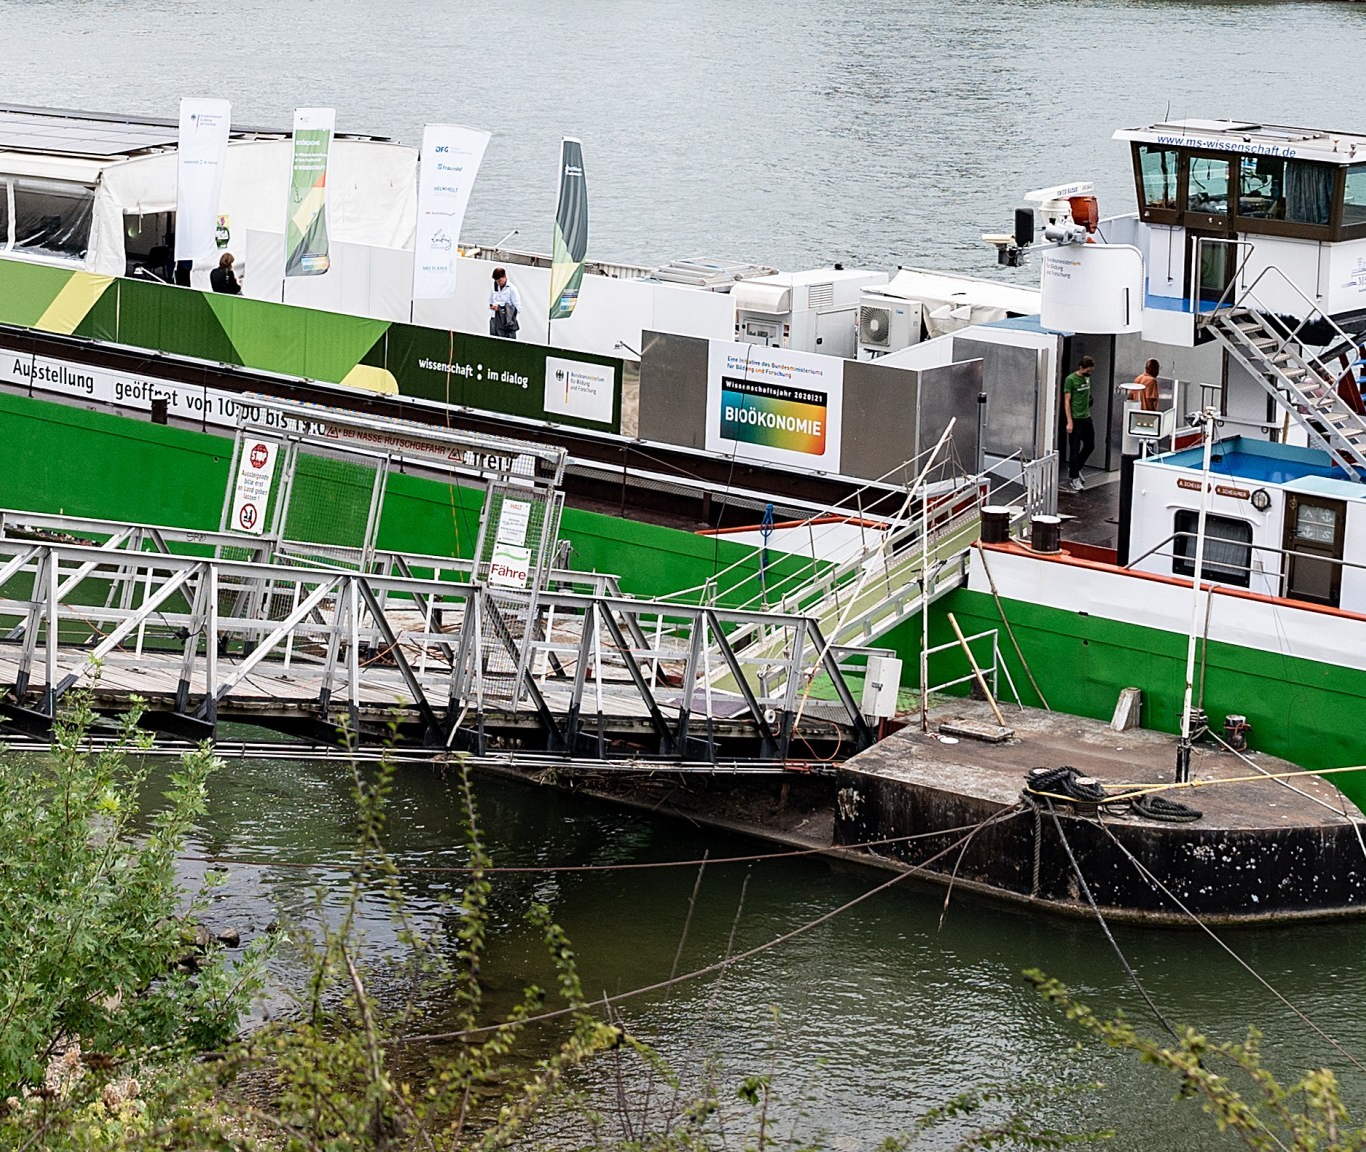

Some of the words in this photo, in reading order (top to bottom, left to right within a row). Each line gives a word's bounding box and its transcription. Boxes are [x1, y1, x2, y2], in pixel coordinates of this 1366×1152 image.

[1157, 136, 1296, 157] www.ms-wissenschaft.de
[418, 358, 473, 378] wissenschaft
[487, 368, 498, 381] im
[501, 371, 528, 389] dialog
[736, 364, 754, 373] Bildng
[765, 369, 792, 379] Forschung
[772, 363, 823, 376] Bundesministeriums
[13, 358, 94, 394] Ausstellung
[186, 396, 212, 414] von
[725, 380, 792, 398] Wissenschaftsjahr
[725, 406, 821, 436] BIOÖKONOMIE
[343, 428, 356, 437] BEI
[385, 434, 446, 455] RUTSCHGEFAHR
[251, 450, 267, 462] STOP
[491, 564, 526, 580] Fähre
